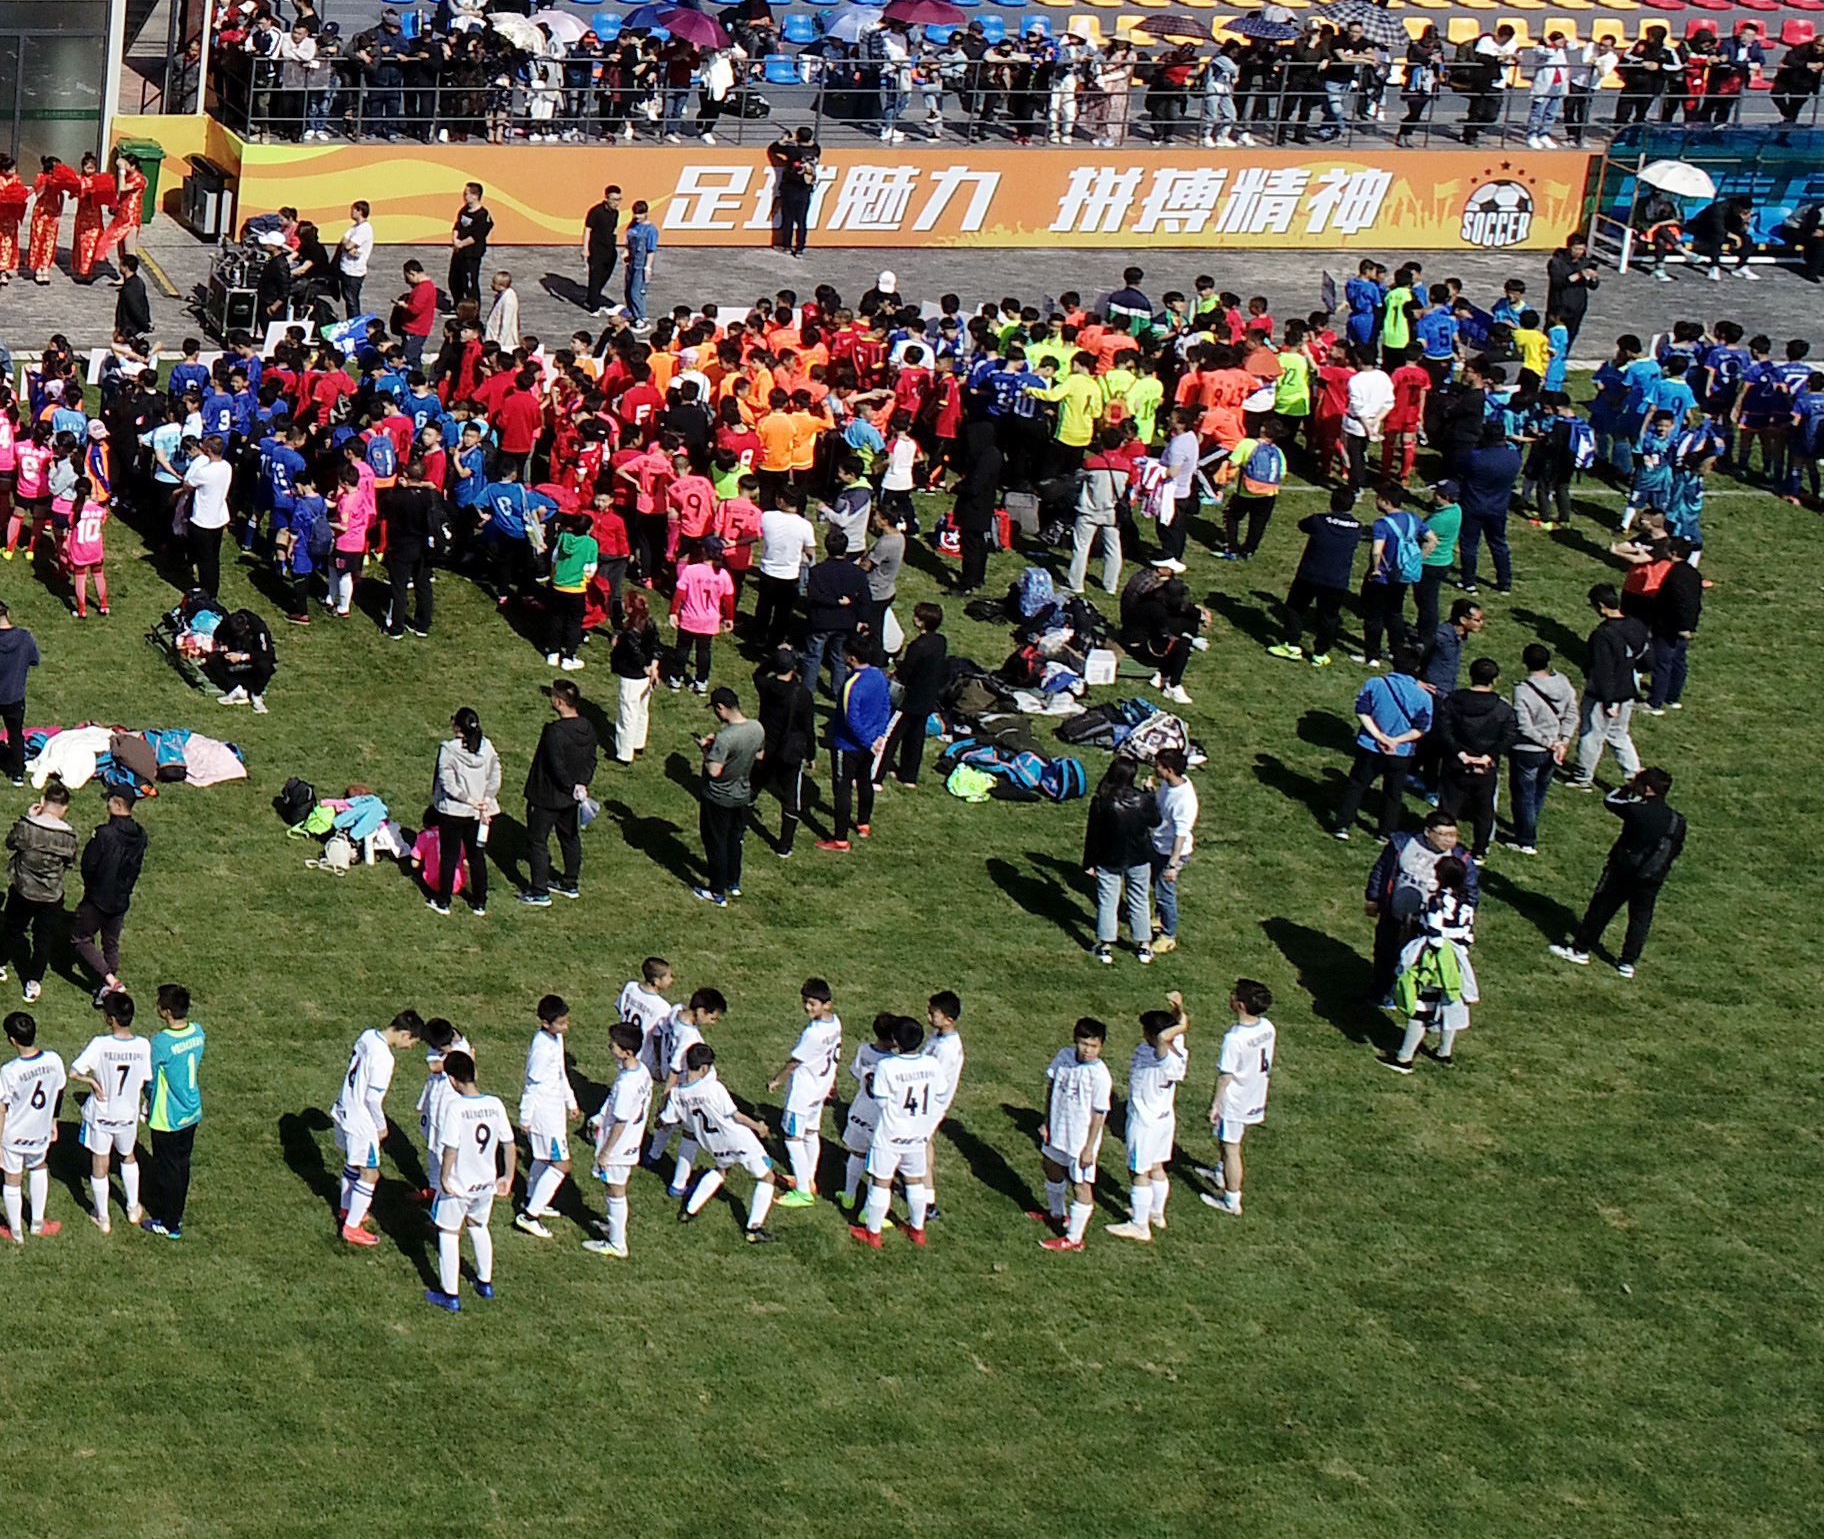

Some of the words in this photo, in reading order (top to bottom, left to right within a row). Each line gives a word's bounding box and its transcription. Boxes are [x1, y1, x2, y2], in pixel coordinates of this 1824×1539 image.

[1056, 164, 1395, 234] 拼搏精神
[1462, 211, 1530, 247] SOCCER
[218, 410, 230, 431] 3
[414, 410, 428, 429] 6
[687, 492, 702, 517] 9
[77, 519, 99, 544] 10
[115, 1064, 131, 1096] 7
[187, 1052, 195, 1089] 1
[30, 1080, 45, 1112] 6
[903, 1084, 928, 1117] 41
[692, 1107, 719, 1135] 2
[475, 1123, 490, 1155] 9
